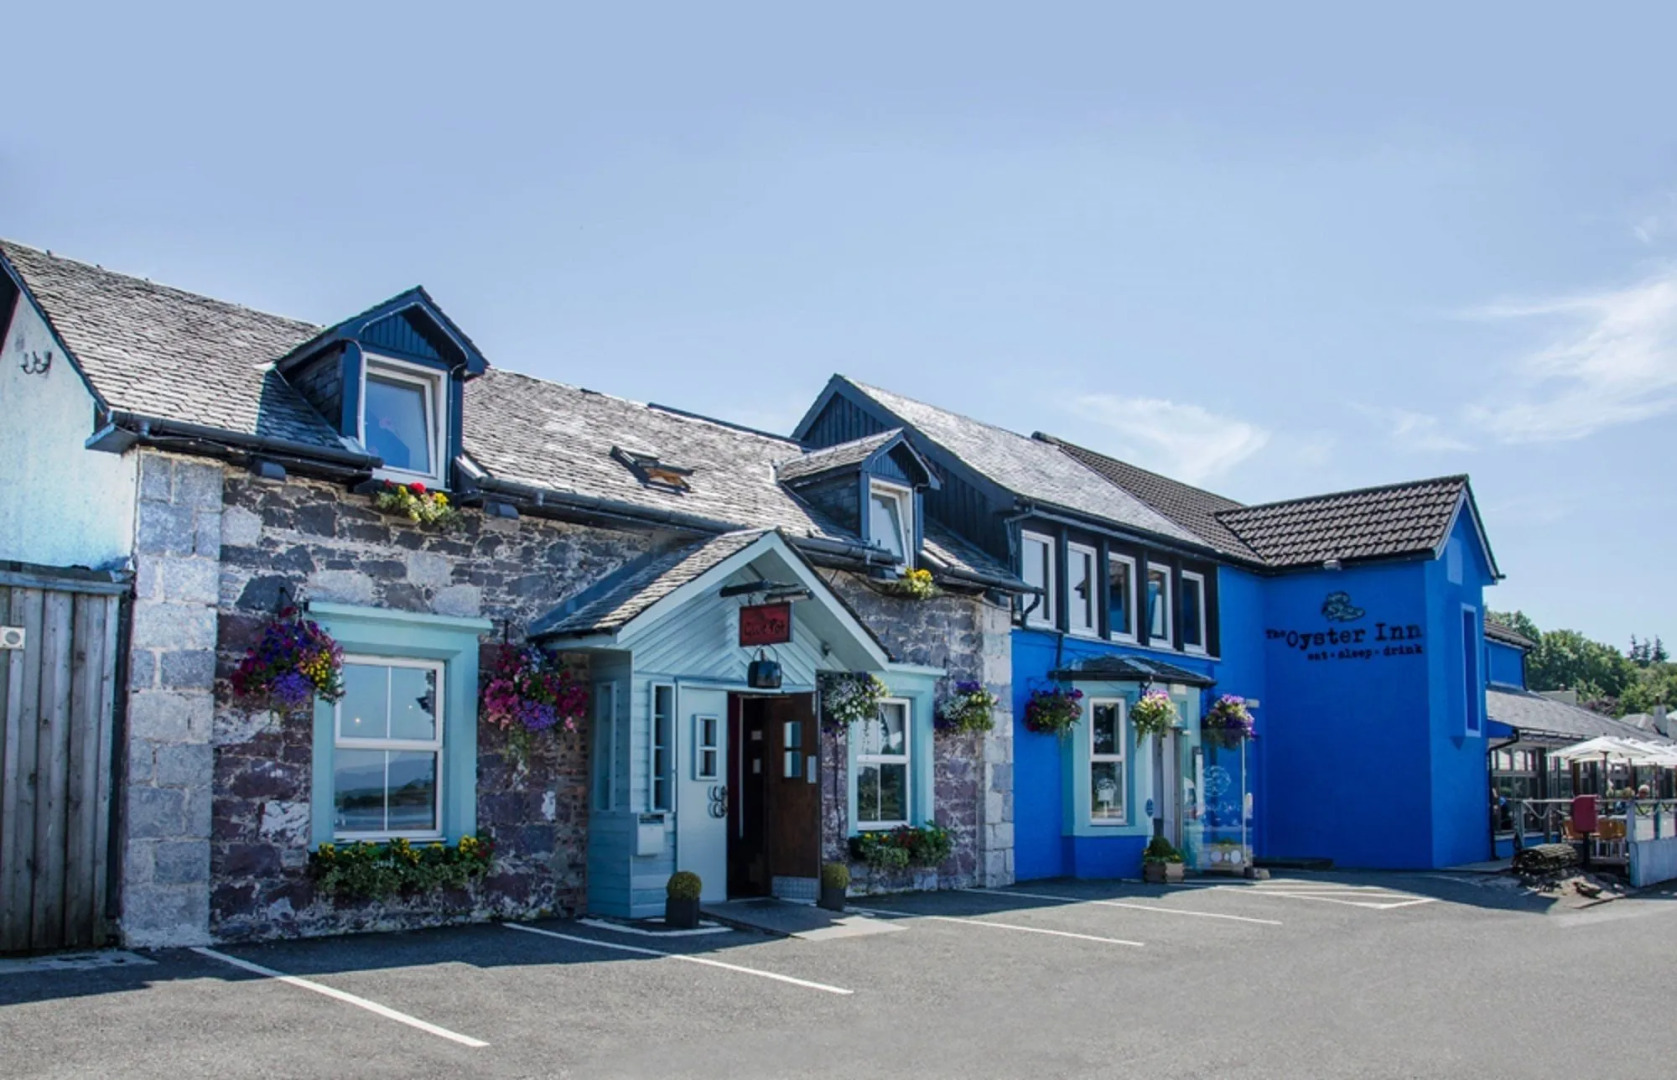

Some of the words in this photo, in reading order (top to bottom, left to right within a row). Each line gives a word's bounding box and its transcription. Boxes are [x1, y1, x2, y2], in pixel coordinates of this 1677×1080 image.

[1286, 627, 1366, 650] Oyster
[1375, 622, 1422, 641] Inn
[1383, 644, 1423, 657] drink
